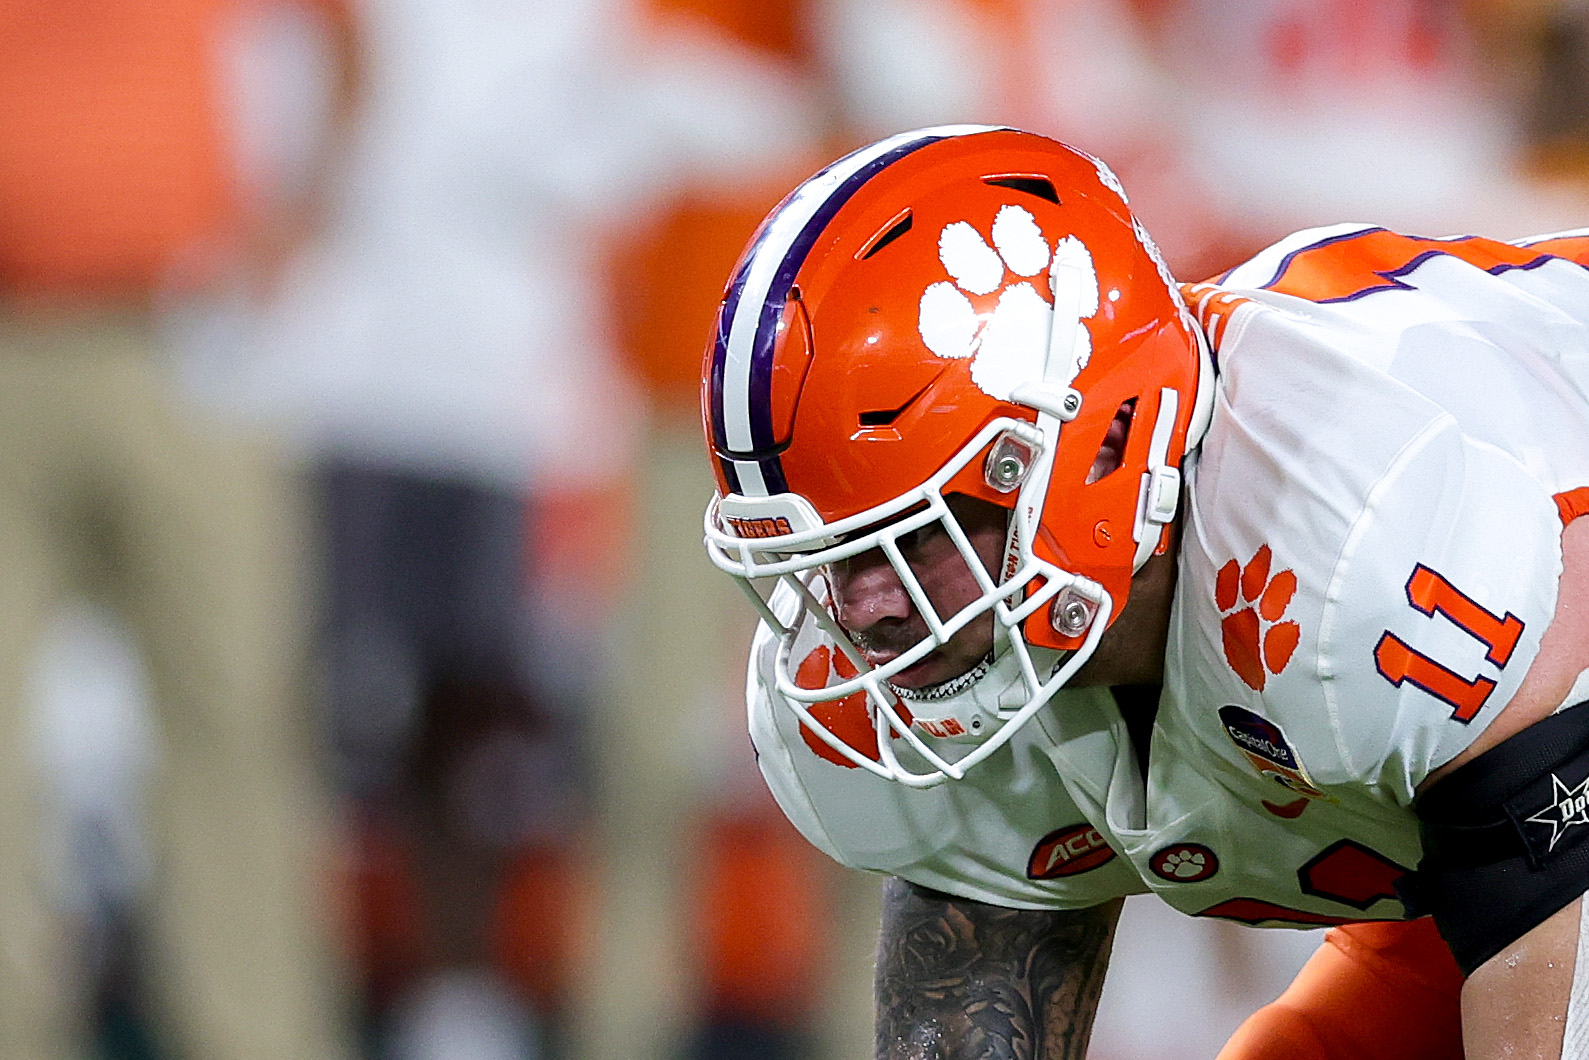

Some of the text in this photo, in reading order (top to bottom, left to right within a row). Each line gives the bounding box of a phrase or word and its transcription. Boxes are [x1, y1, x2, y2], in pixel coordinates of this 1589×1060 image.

[726, 515, 794, 538] TIGERS
[1373, 562, 1526, 725] 11
[1045, 828, 1107, 872] ACC
